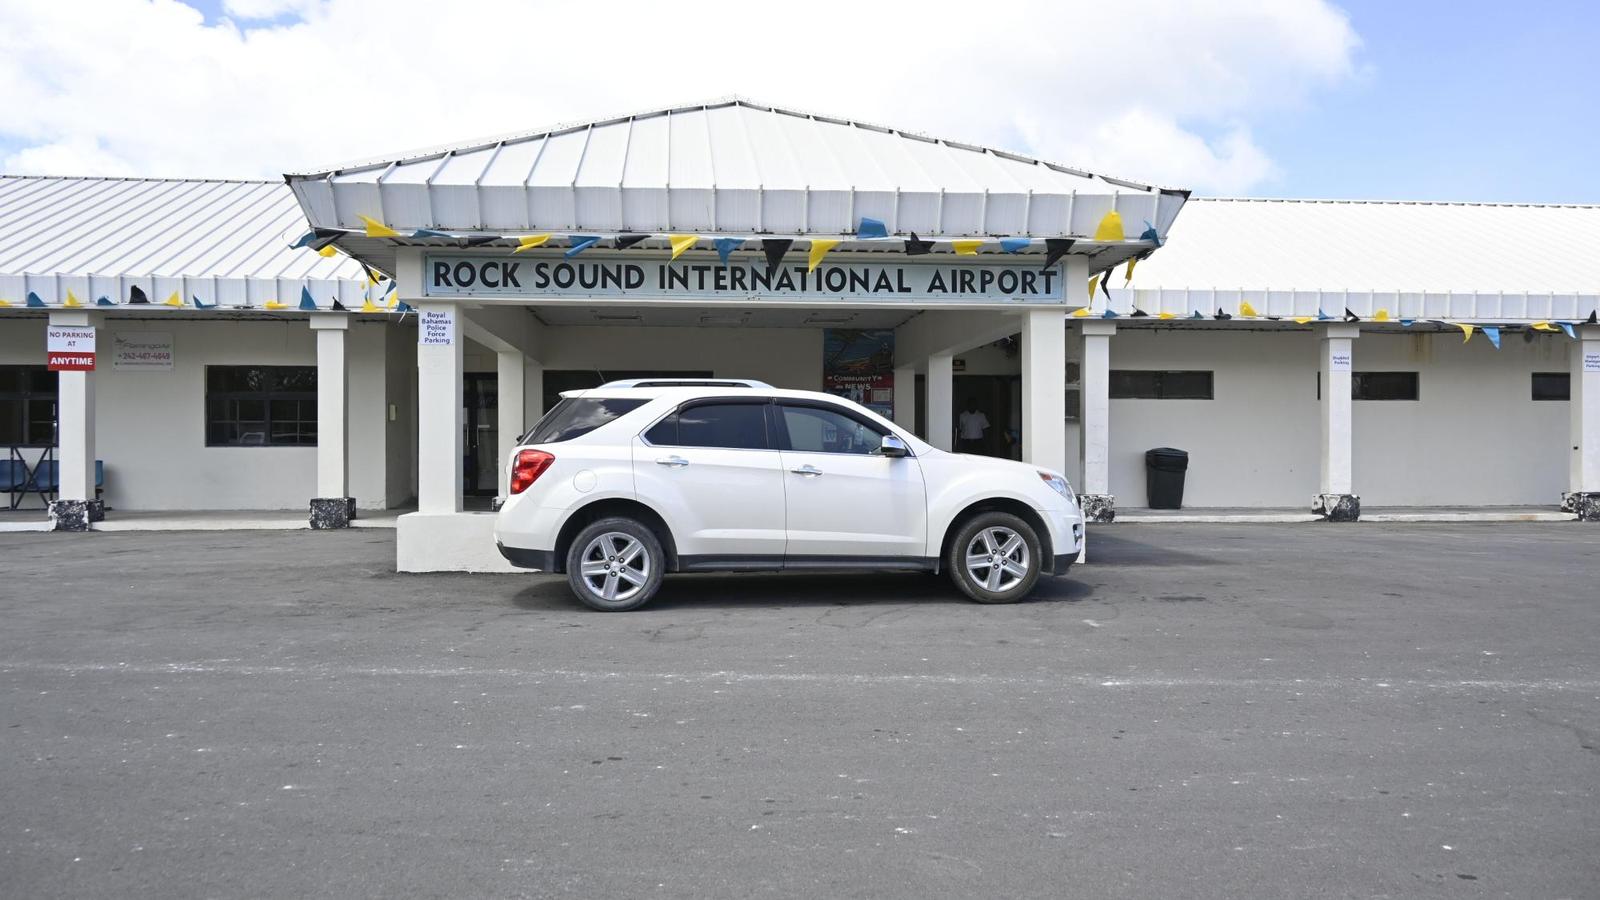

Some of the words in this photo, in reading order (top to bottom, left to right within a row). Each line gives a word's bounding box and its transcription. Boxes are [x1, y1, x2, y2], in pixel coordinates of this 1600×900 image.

[434, 261, 521, 288] ROCK
[535, 262, 645, 290] SOUND
[659, 264, 912, 293] INTERNATIONAL
[926, 268, 1058, 295] AIRPORT
[424, 337, 451, 345] Parking
[50, 357, 94, 366] ANYTIME
[844, 383, 871, 391] NEWS
